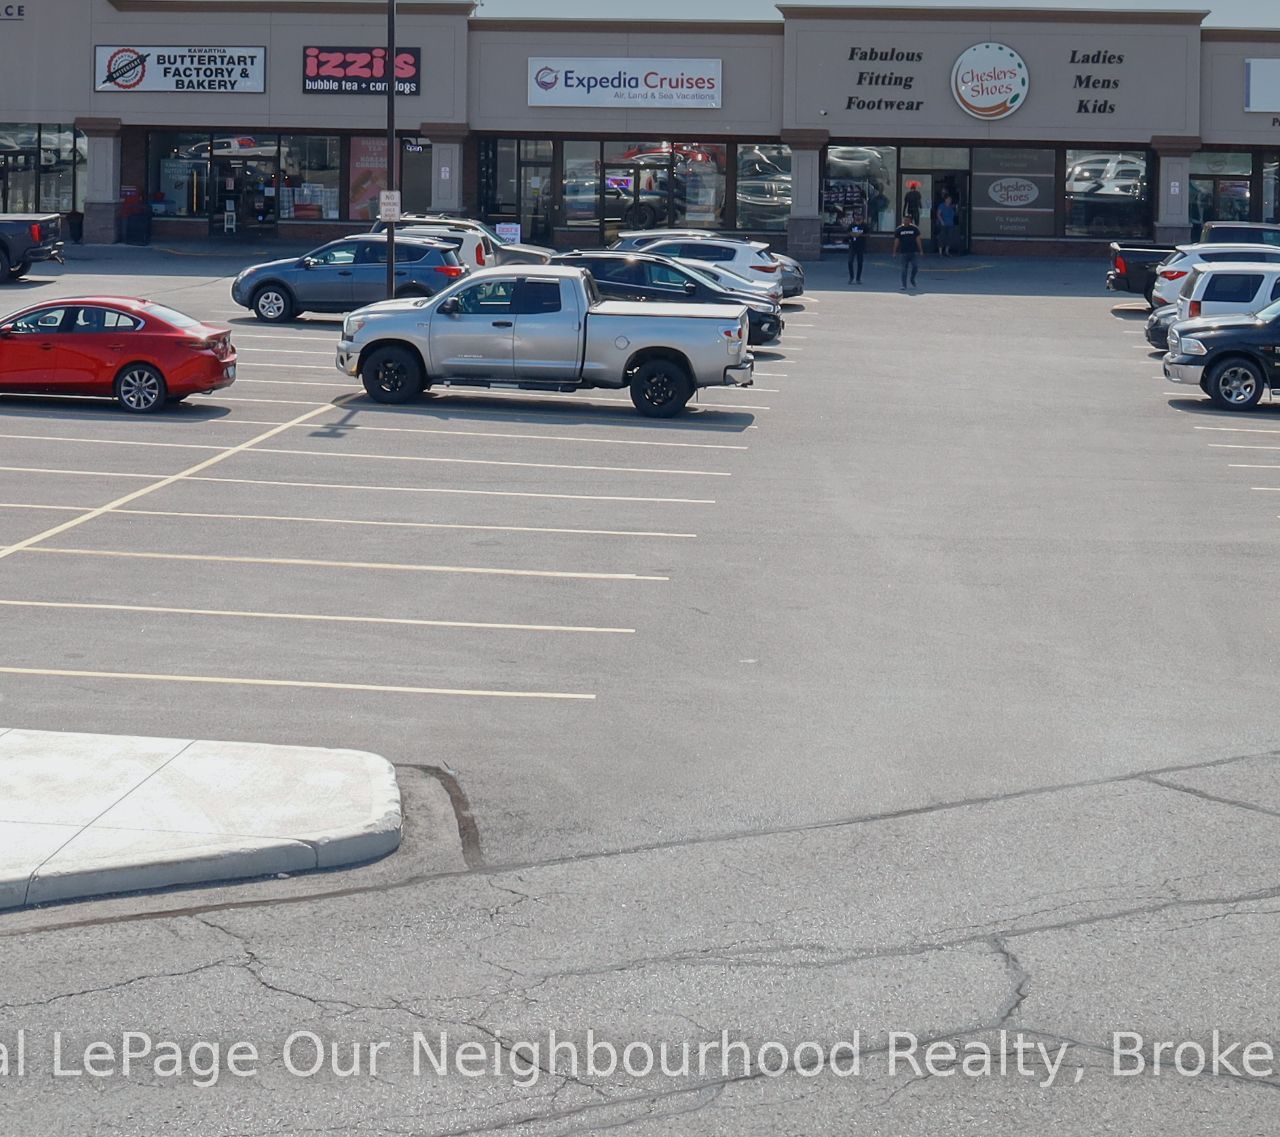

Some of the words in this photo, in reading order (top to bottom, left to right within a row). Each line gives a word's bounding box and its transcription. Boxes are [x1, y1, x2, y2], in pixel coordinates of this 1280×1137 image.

[157, 54, 257, 66] BUTTERTART
[848, 47, 923, 62] Fabulous
[1069, 50, 1125, 64] Ladies
[306, 47, 416, 78] izzis
[164, 67, 235, 78] FACTORY
[239, 68, 250, 79] &
[856, 71, 914, 89] Fitting
[961, 67, 1017, 85] Cheslers
[175, 79, 238, 90] BAKERY
[305, 80, 339, 90] bubble
[342, 80, 358, 90] tea
[395, 82, 416, 94] ogs
[564, 70, 639, 94] Expedia
[644, 71, 715, 90] Cruises
[1073, 74, 1120, 89] Mens
[628, 92, 648, 100] Land
[650, 92, 656, 100] &
[658, 92, 673, 100] Sea
[676, 92, 715, 101] Vacations
[970, 83, 1013, 98] Shoes
[845, 96, 924, 111] Footwear
[1076, 99, 1116, 114] Kids
[993, 182, 1033, 193] Cheslers
[1000, 191, 1030, 203] Shoes
